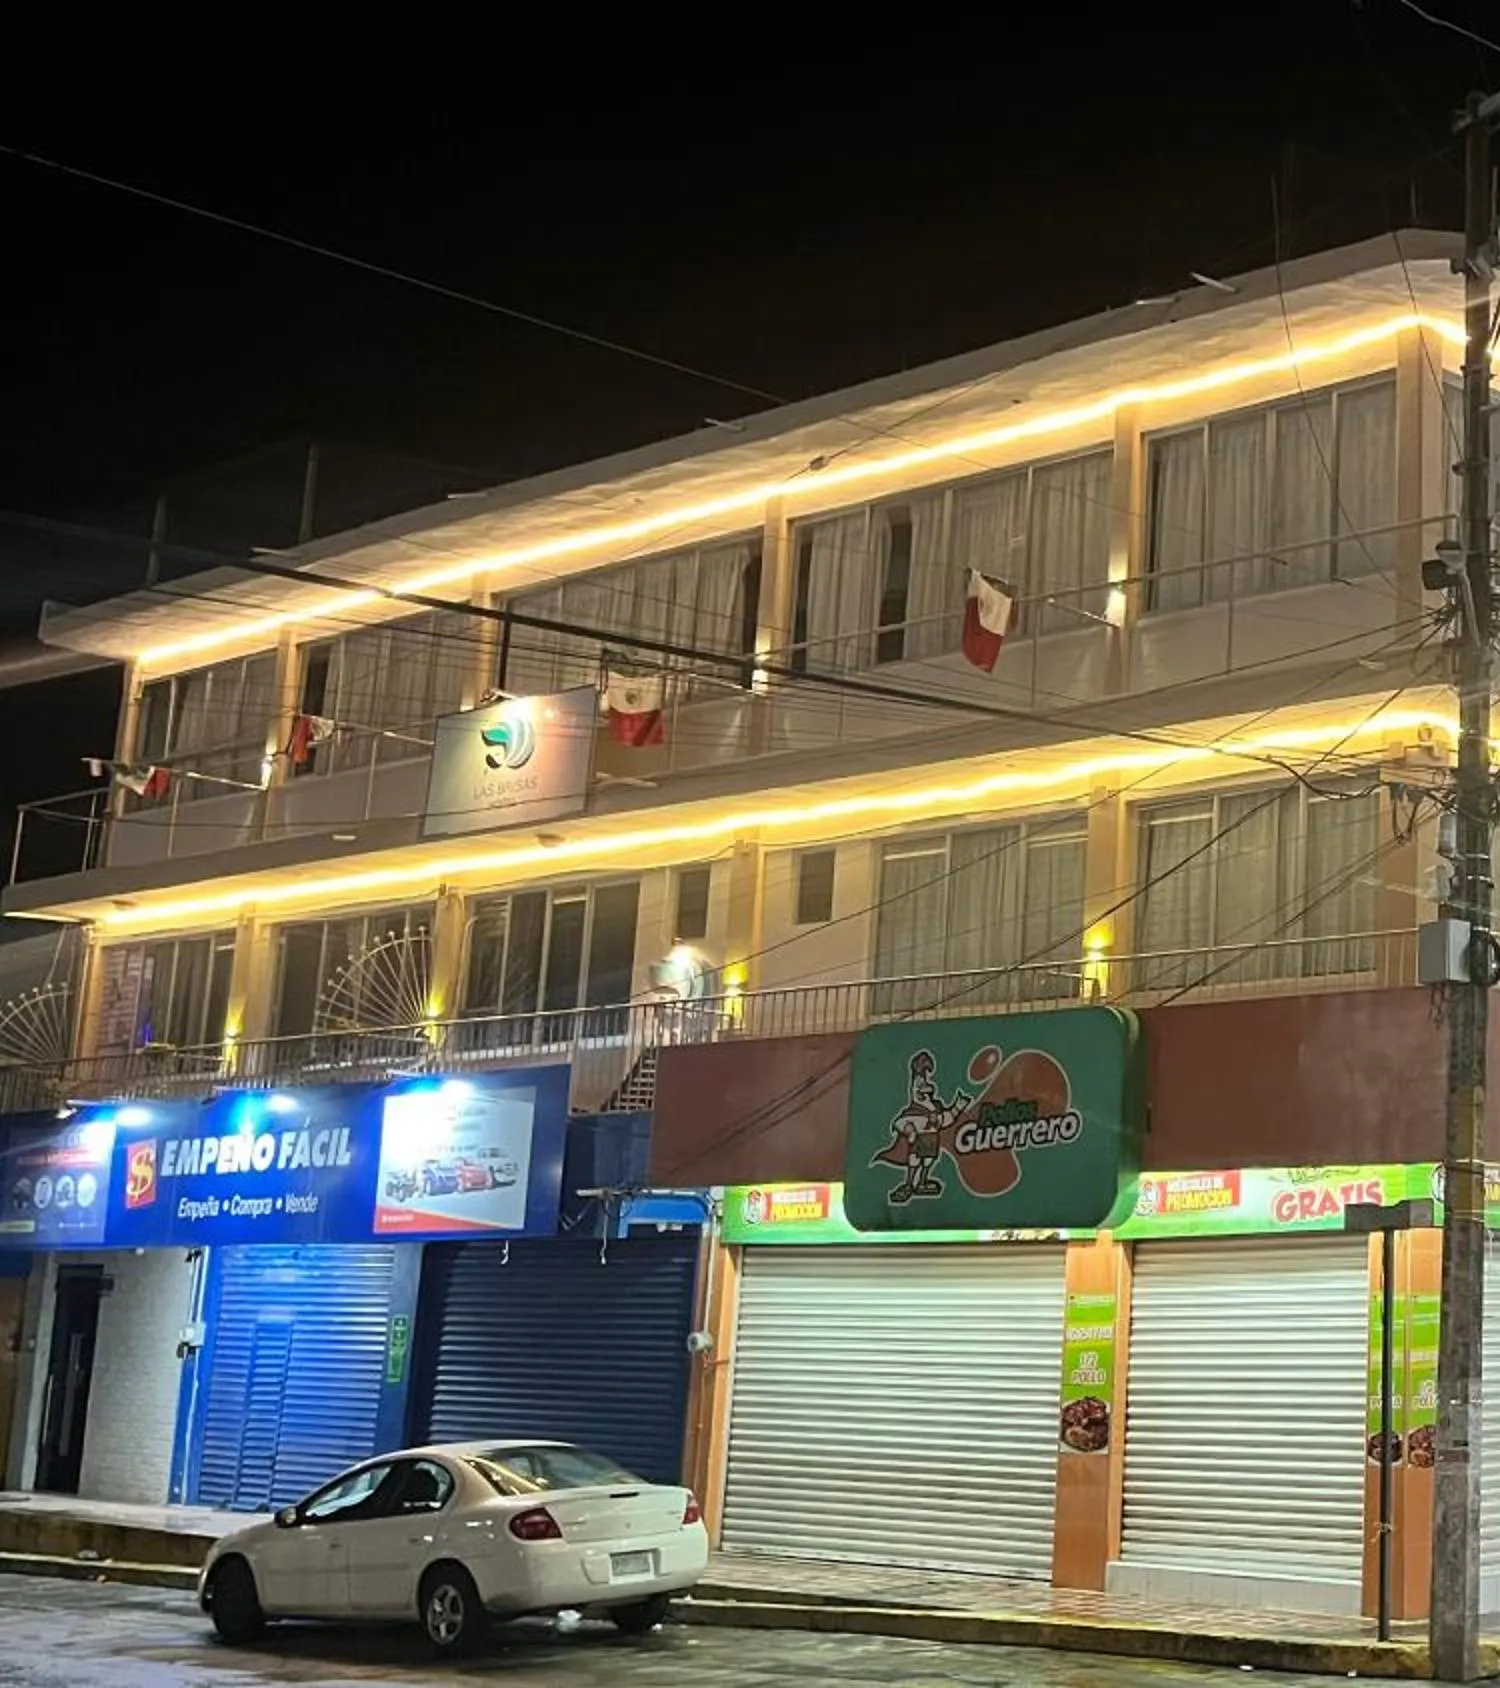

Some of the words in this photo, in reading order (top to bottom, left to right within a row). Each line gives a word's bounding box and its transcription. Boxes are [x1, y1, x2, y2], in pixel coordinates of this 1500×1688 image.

[473, 782, 495, 800] LAS
[277, 1117, 352, 1169] FÁCIL
[955, 1113, 1081, 1154] Guerrero
[230, 1193, 272, 1218] Compra
[285, 1192, 319, 1213] Vende
[1274, 1180, 1383, 1223] GRATIS
